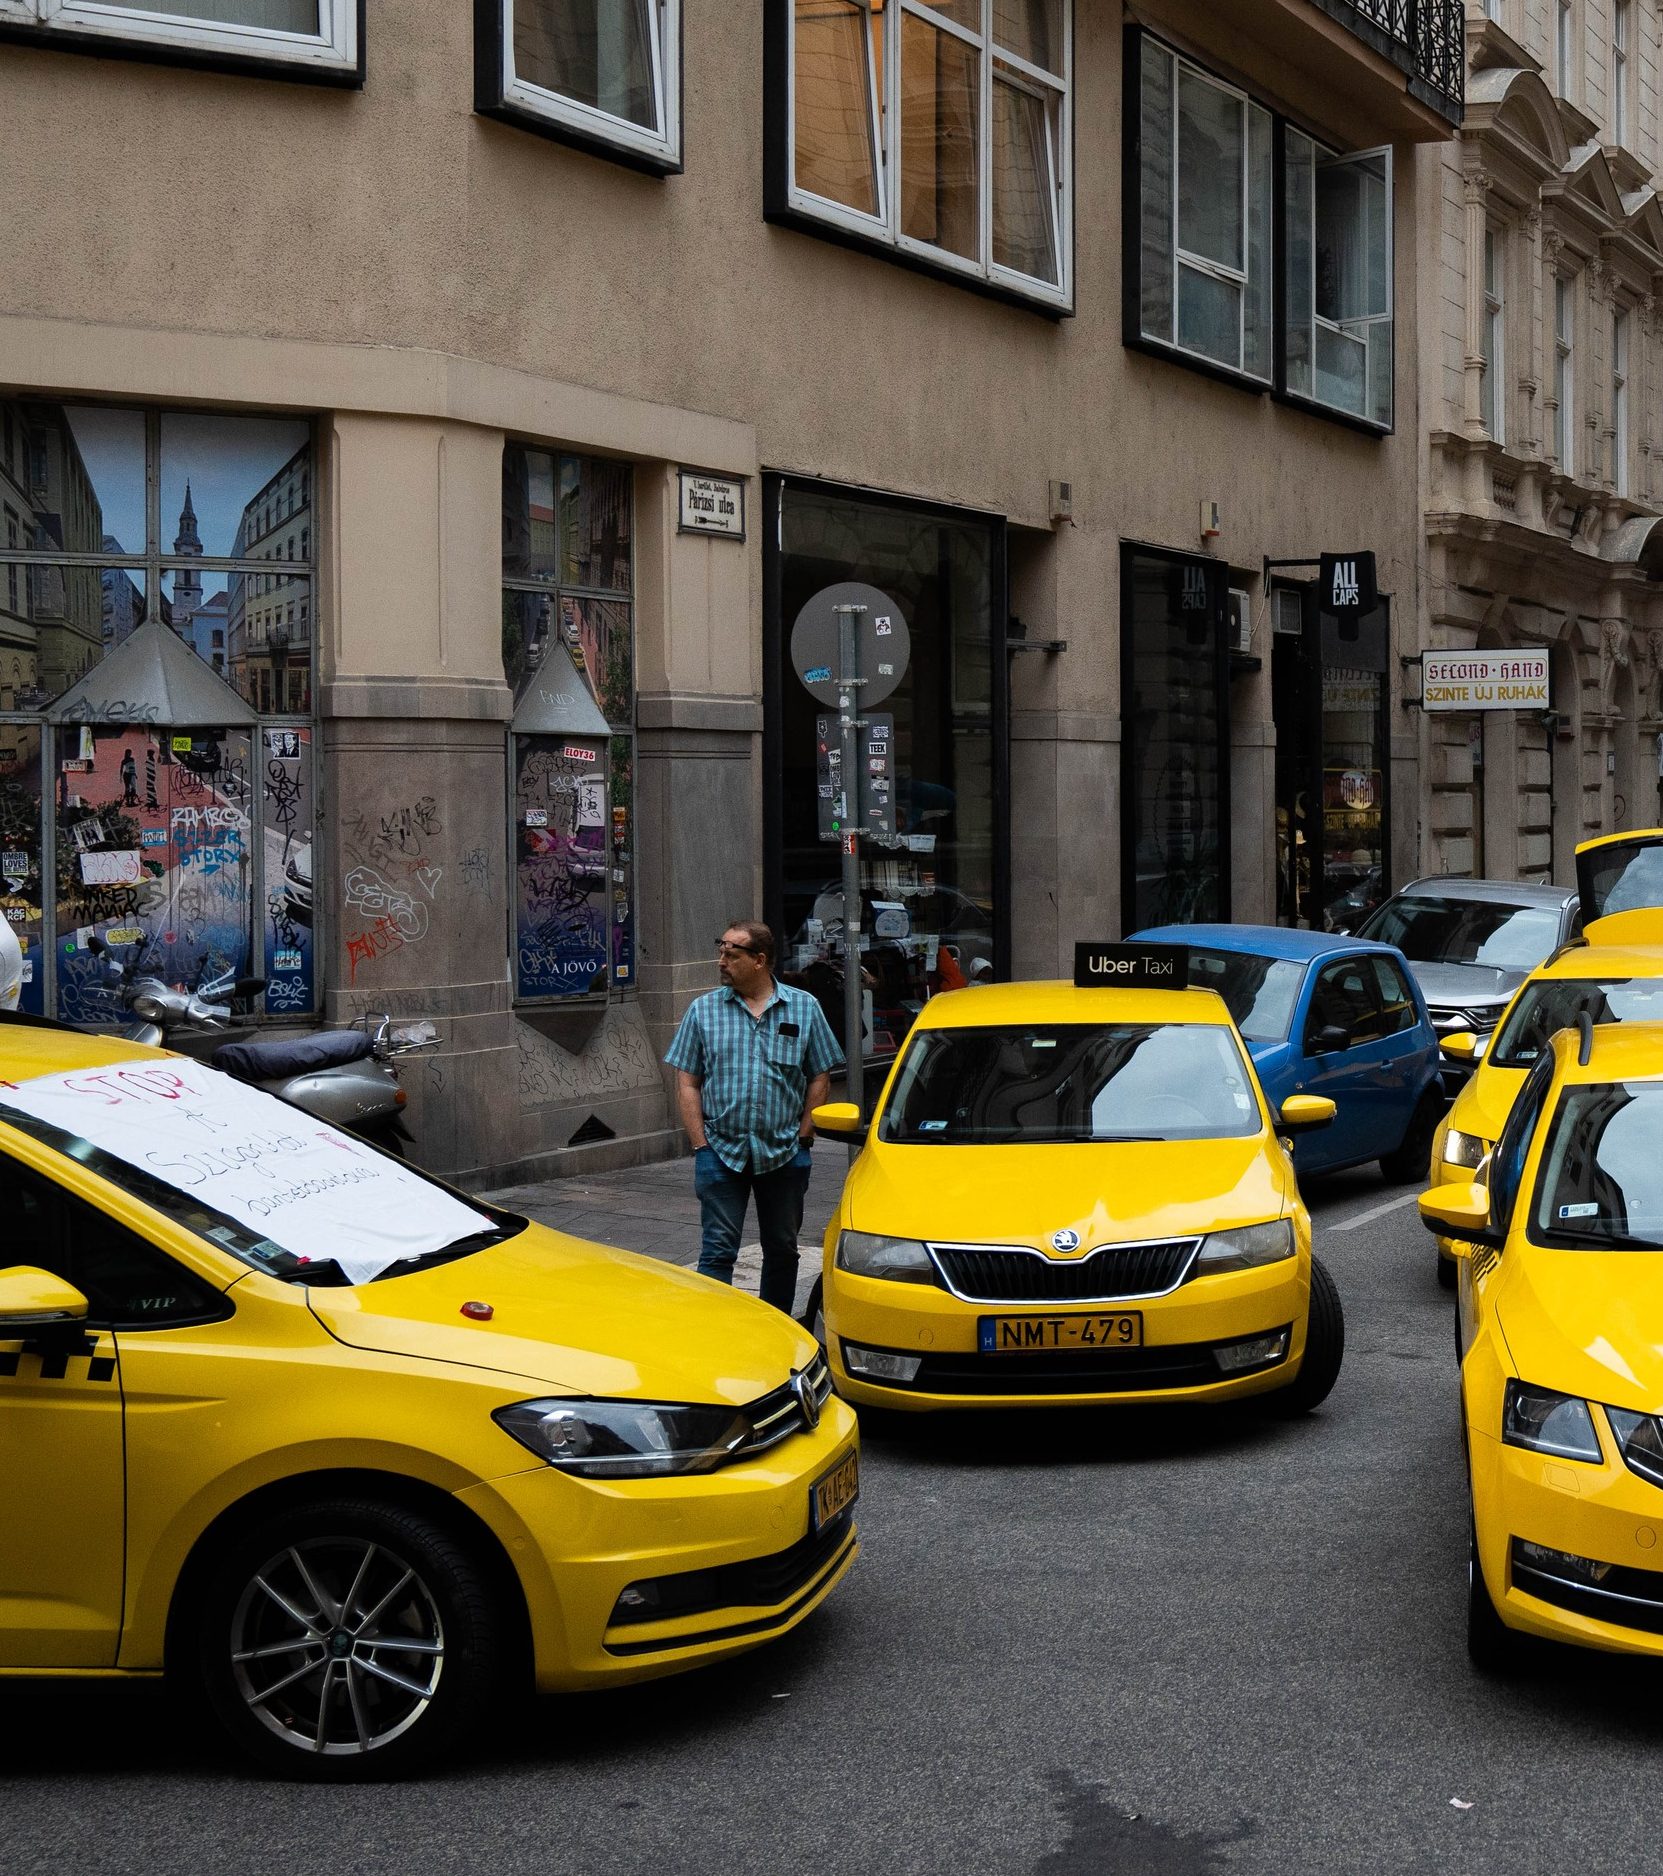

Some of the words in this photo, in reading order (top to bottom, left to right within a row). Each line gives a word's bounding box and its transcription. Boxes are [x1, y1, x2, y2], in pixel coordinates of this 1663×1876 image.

[689, 489, 714, 512] Párizsi
[719, 495, 735, 515] utca
[1333, 561, 1359, 588] ALL
[1333, 589, 1359, 605] CAPS
[1500, 662, 1544, 681] HAND
[1425, 687, 1469, 701] SZINTE
[1475, 683, 1493, 700] ÚJ
[1498, 683, 1547, 700] RUHÁK
[565, 748, 594, 760] ELOY36
[870, 744, 886, 753] TEEK
[551, 963, 560, 974] A
[563, 958, 597, 976] JÖVŐ
[1088, 956, 1137, 974] Uber
[1141, 956, 1174, 975] Taxi
[64, 1070, 202, 1104] STOP
[1002, 1317, 1133, 1346] NMT-479
[984, 1337, 993, 1347] H
